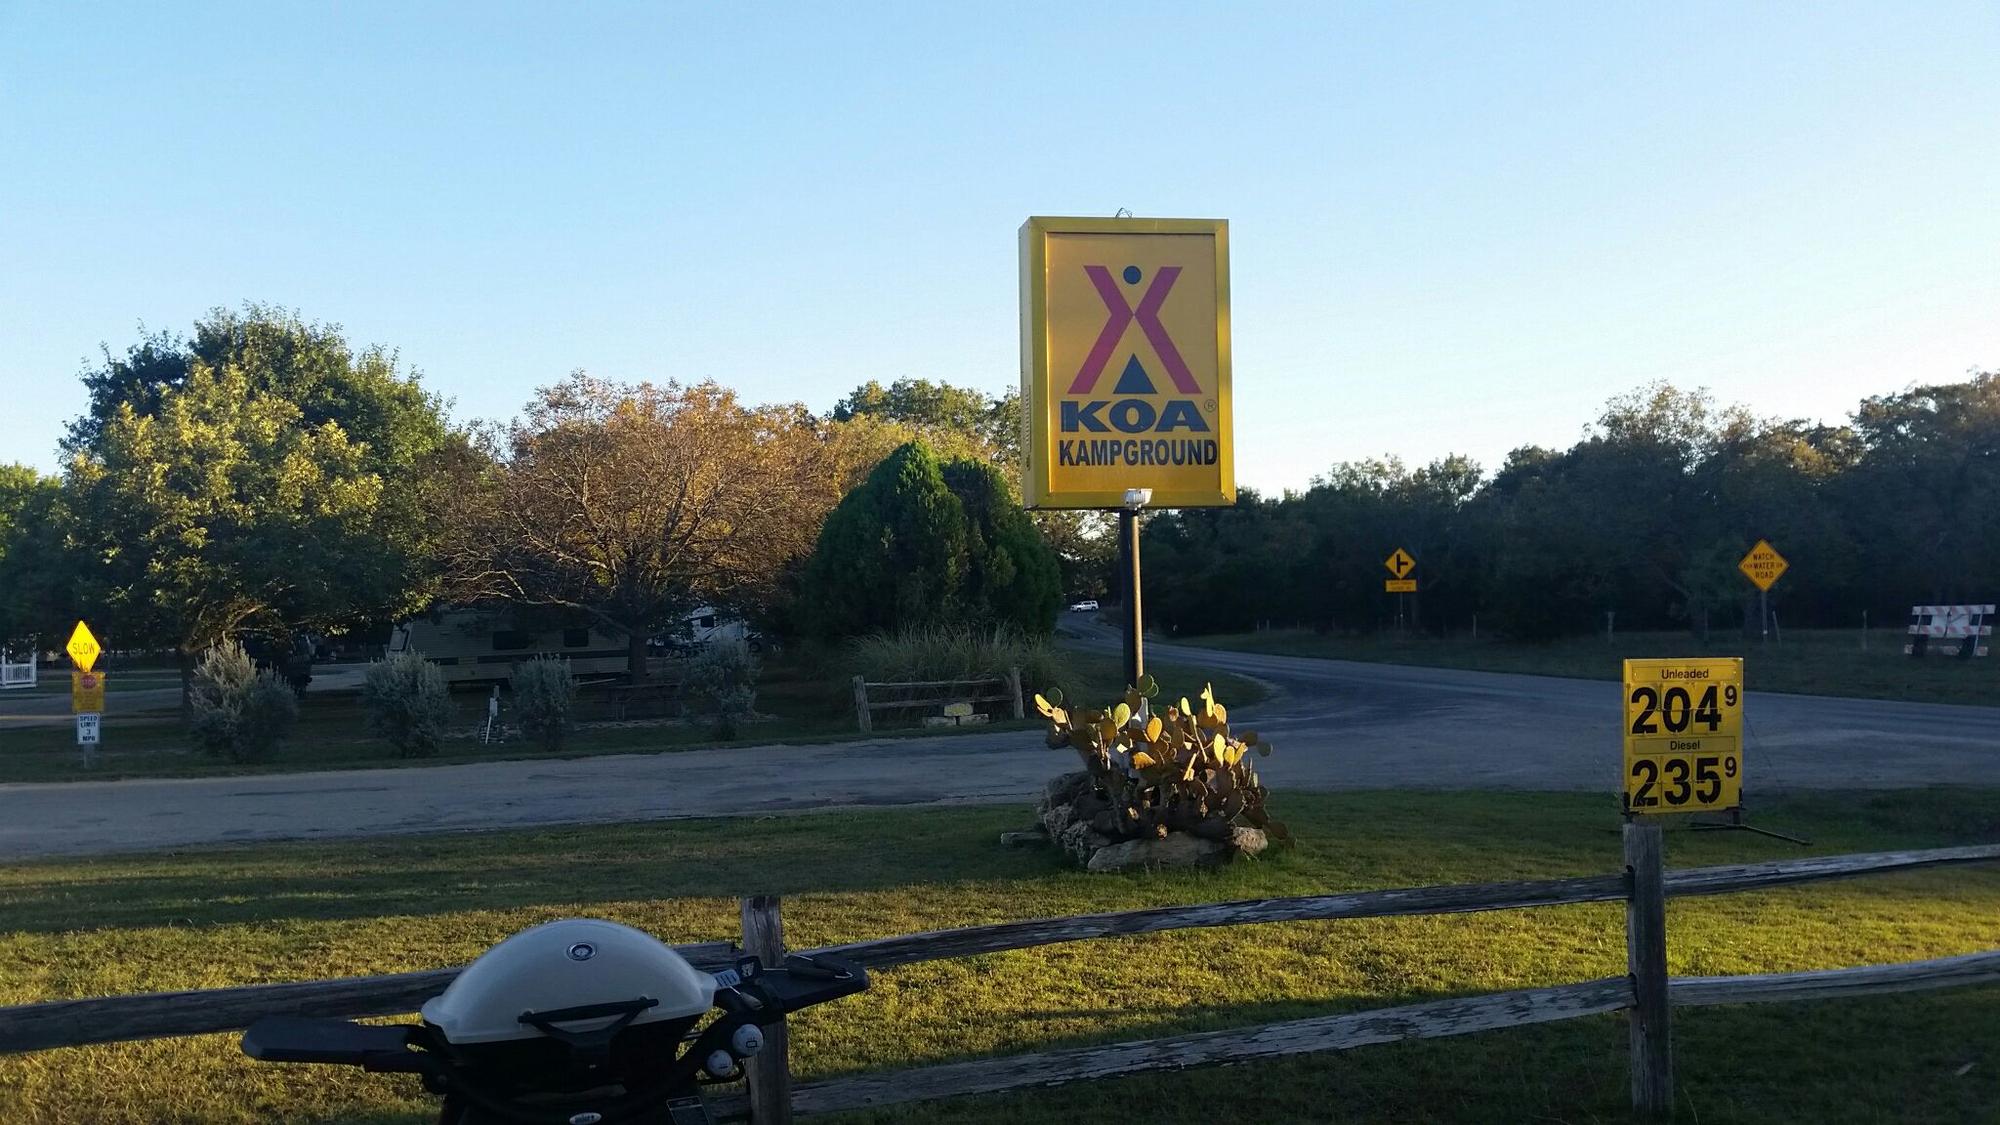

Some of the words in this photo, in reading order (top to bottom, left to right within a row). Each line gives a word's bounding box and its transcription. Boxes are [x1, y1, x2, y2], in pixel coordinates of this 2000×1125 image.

[1060, 399, 1210, 433] KOA
[1059, 439, 1218, 467] KAMPGROUND
[72, 642, 95, 655] SLOW
[1661, 668, 1709, 679] Unleaded
[1670, 740, 1701, 750] Diesel
